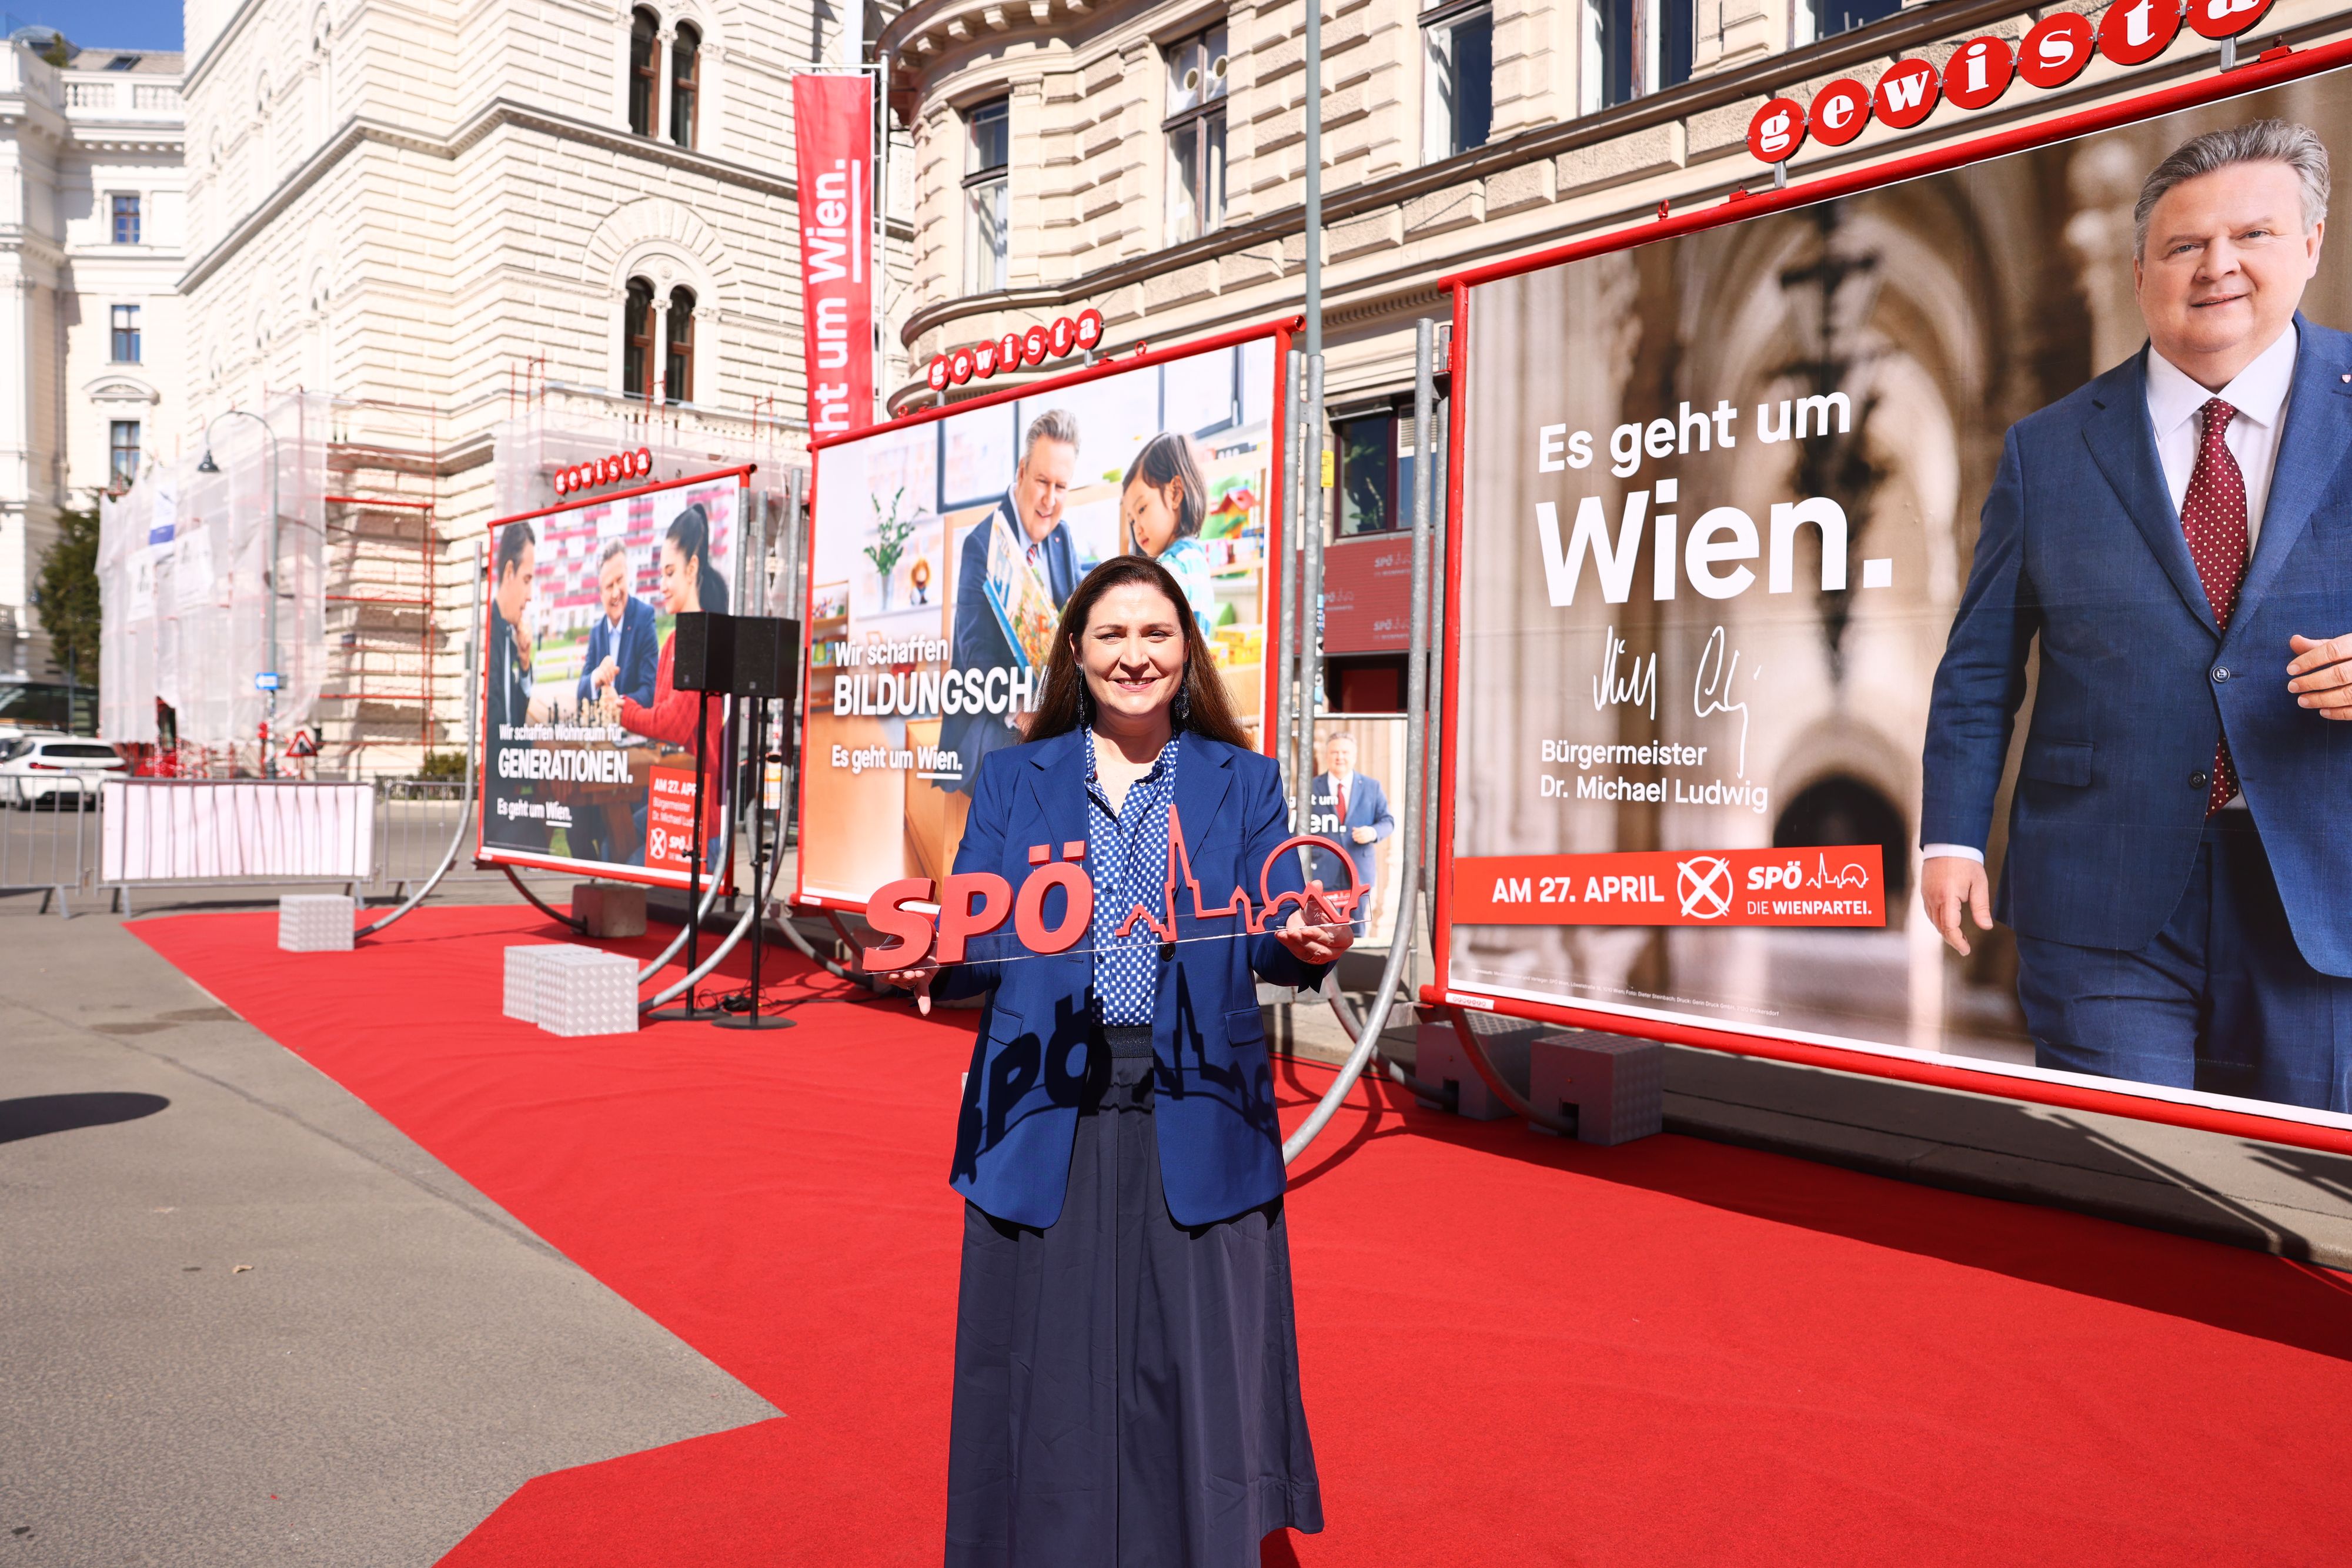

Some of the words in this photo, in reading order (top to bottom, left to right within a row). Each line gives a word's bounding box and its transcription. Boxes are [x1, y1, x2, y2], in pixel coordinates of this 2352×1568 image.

[805, 158, 847, 285] Wien.
[816, 298, 848, 369] um
[931, 317, 1096, 386] gewista
[1538, 423, 1593, 473] Es
[1610, 399, 1738, 478] geht
[1757, 392, 1851, 444] um
[556, 453, 648, 492] gewista
[1535, 477, 1892, 607] Wien.
[834, 640, 863, 667] Wir
[867, 633, 948, 666] schaffen
[833, 665, 1045, 716] BILDUNGSCH
[499, 724, 513, 740] Wir
[514, 723, 554, 741] schaffen
[554, 723, 606, 741] Wohnraum
[607, 723, 624, 741] für
[498, 748, 633, 784] GENERATIONEN.
[831, 744, 848, 768] Es
[851, 744, 886, 775] geht
[888, 748, 913, 770] um
[917, 744, 963, 771] Wien.
[1541, 740, 1707, 770] Bürgermeister
[653, 778, 667, 793] AM
[667, 780, 680, 795] 27.
[1318, 795, 1339, 805] um
[1541, 774, 1568, 798] Dr.
[1576, 775, 1666, 803] Michael
[1675, 779, 1768, 814] Ludwig
[497, 798, 508, 815] Es
[508, 799, 529, 821] geht
[529, 803, 544, 818] um
[546, 801, 572, 821] Wien.
[1492, 878, 1532, 904] AM
[1539, 877, 1576, 903] 27.
[1583, 875, 1665, 903] APRIL
[1746, 860, 1802, 890] SPÖ
[862, 840, 1094, 971] SPÖ
[1747, 901, 1769, 915] DIE
[1772, 900, 1872, 915] WIENPARTEI.
[1749, 1007, 1779, 1017] Wolkersdorf
